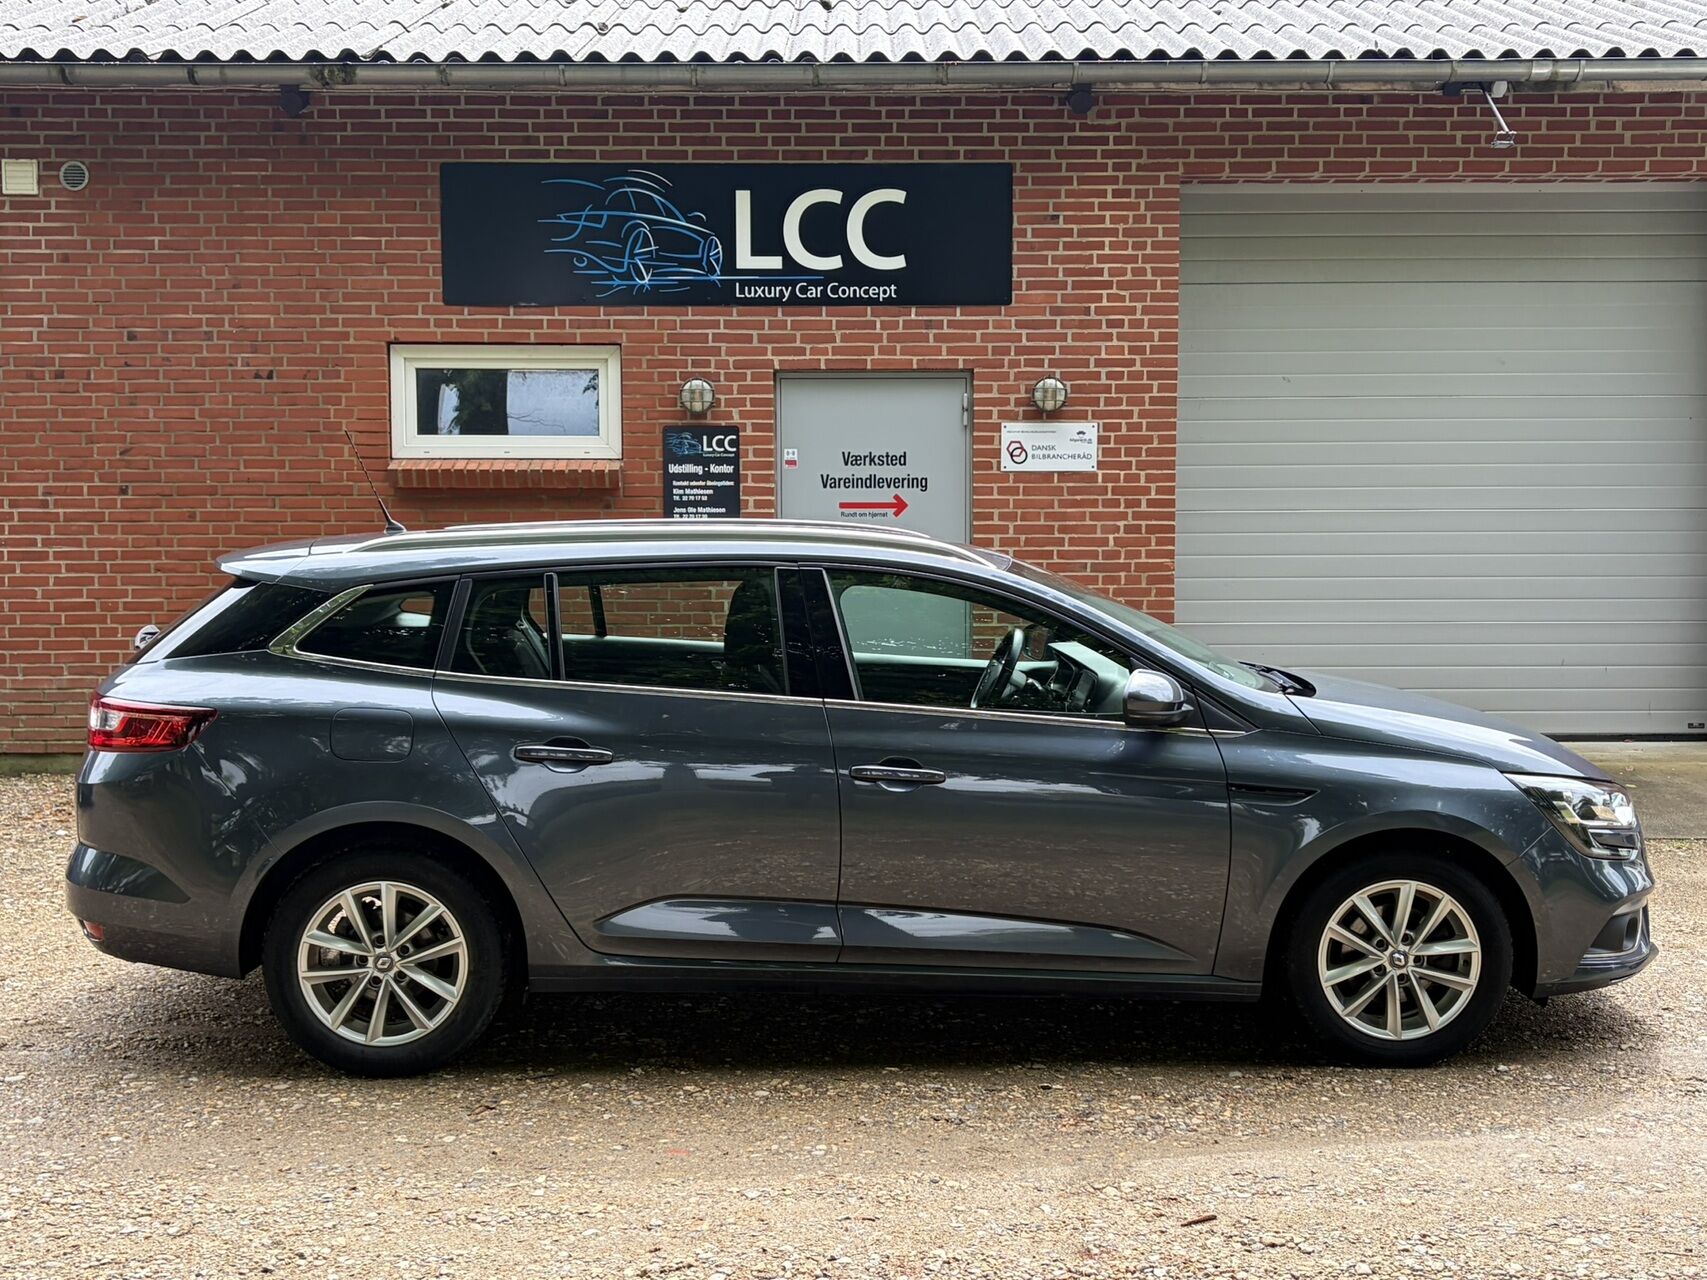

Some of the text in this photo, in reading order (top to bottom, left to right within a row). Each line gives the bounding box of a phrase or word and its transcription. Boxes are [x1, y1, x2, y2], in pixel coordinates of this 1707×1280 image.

[735, 188, 907, 270] LCC
[735, 282, 897, 302] Luxury Car Concept
[702, 435, 737, 452] LCC
[841, 451, 907, 466] Værksted
[1031, 452, 1092, 460] BILBRANCHERÅD
[668, 463, 703, 475] Udstilling
[709, 463, 734, 473] Kontor
[820, 474, 928, 492] Vareindlevering
